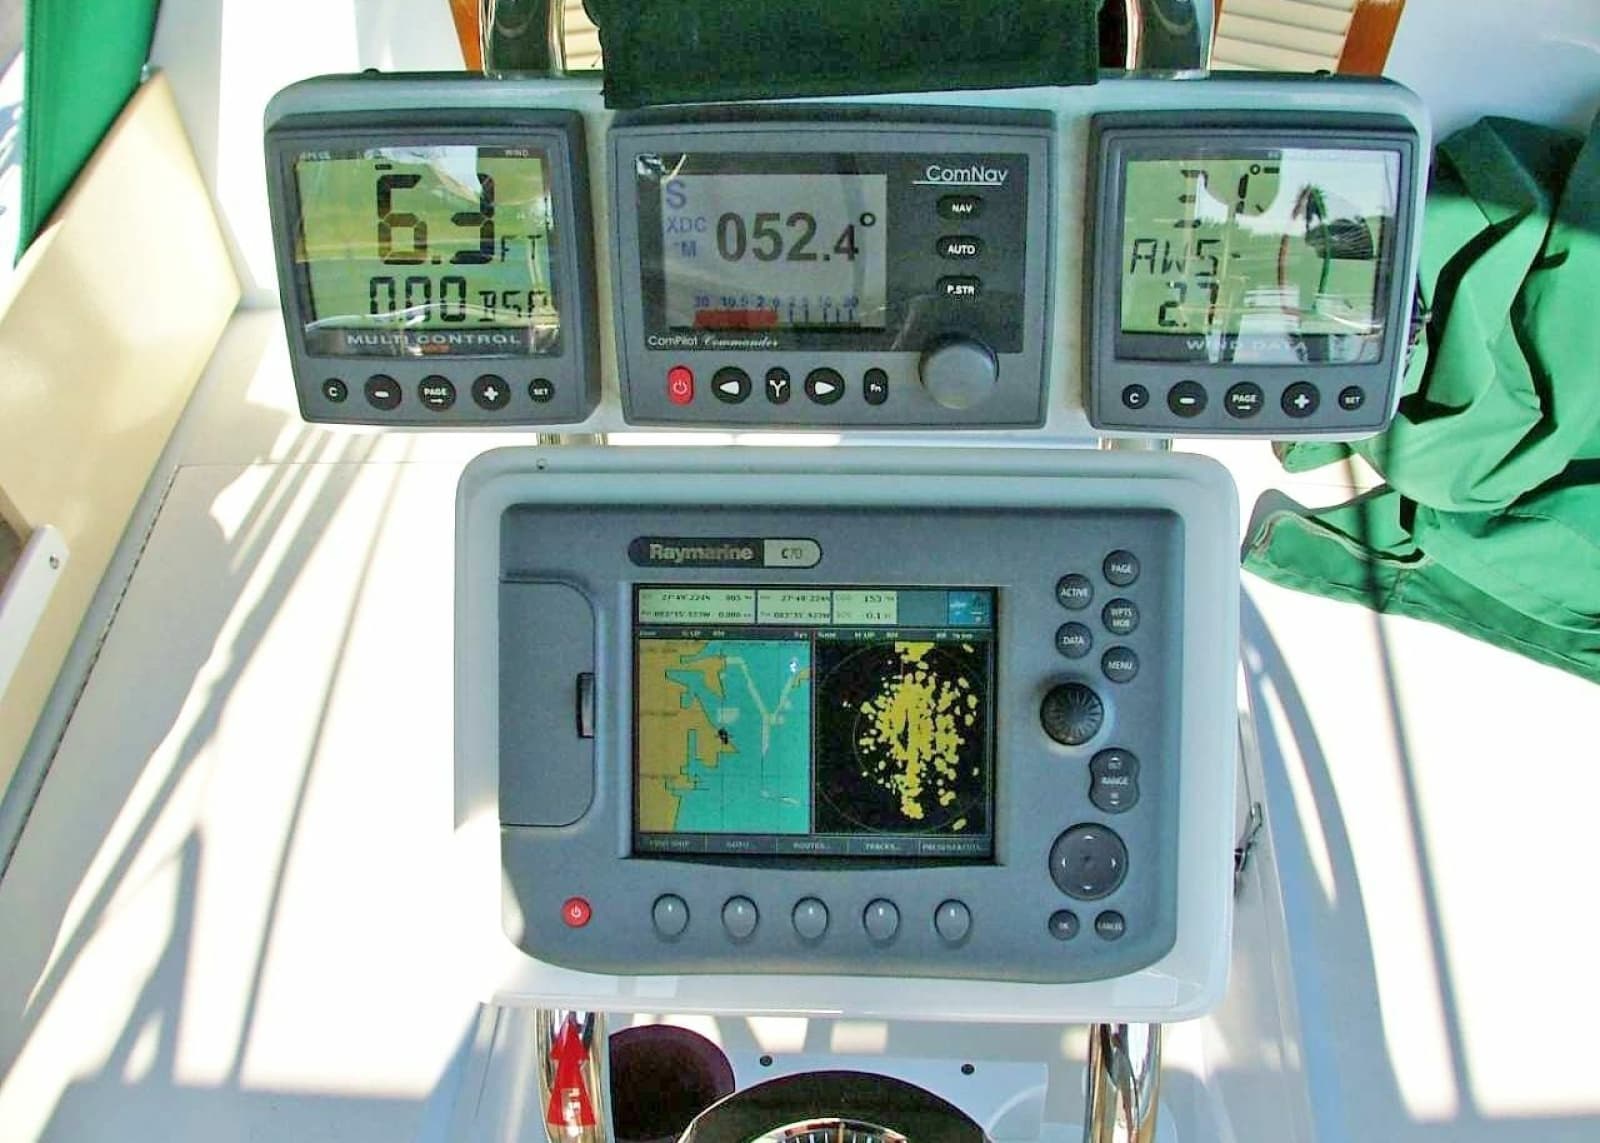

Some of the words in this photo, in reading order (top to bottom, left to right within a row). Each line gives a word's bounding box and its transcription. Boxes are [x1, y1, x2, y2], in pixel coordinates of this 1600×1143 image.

[926, 165, 1008, 184] ComNav
[666, 180, 687, 210] S
[951, 203, 973, 213] NAV
[666, 215, 707, 233] XDC
[947, 245, 976, 255] AUTO
[946, 285, 975, 295] P.STR
[347, 334, 409, 345] MULTI
[417, 334, 521, 345] CONTROL
[648, 335, 698, 347] ComPilot
[701, 334, 780, 347] Commander
[328, 386, 338, 397] C
[424, 387, 448, 397] PAGE
[533, 387, 549, 395] SET
[870, 383, 882, 393] Fn
[1129, 393, 1140, 403] C
[1232, 394, 1256, 404] PAGE
[1345, 396, 1361, 404] SET
[649, 543, 754, 563] Raymarine
[1110, 564, 1132, 573] PAGE
[1061, 588, 1088, 597] ACTIVE
[1063, 636, 1084, 645] DATA
[1108, 661, 1132, 670] MENU
[1101, 776, 1128, 785] RANGE
